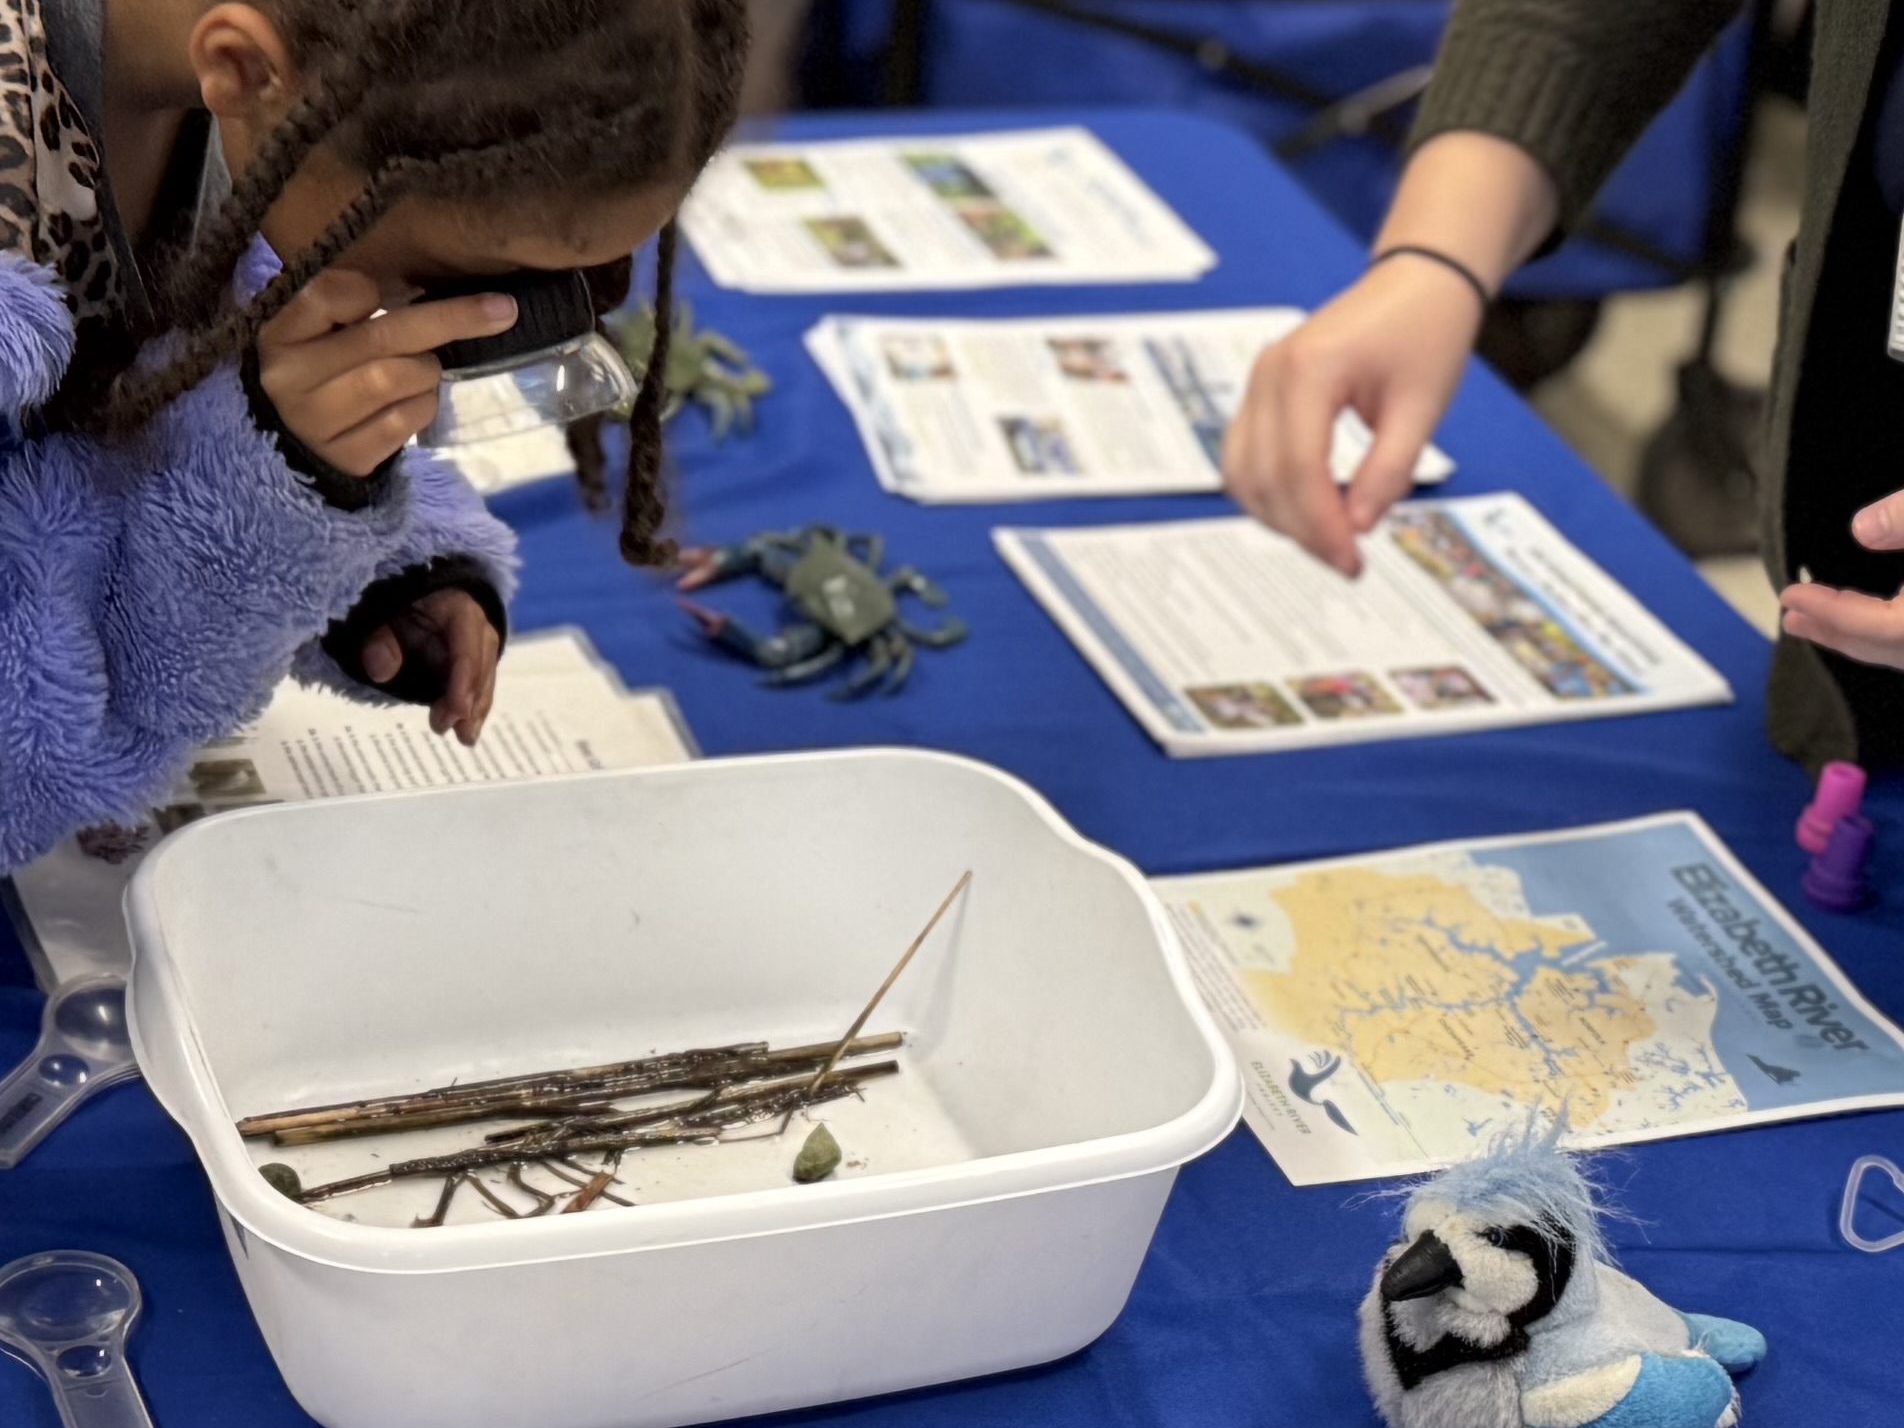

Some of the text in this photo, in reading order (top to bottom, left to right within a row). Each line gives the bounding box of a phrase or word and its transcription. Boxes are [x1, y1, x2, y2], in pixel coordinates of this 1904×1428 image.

[1666, 896, 1794, 1030] Watershed Map
[1670, 861, 1871, 1051] Elizabeth River
